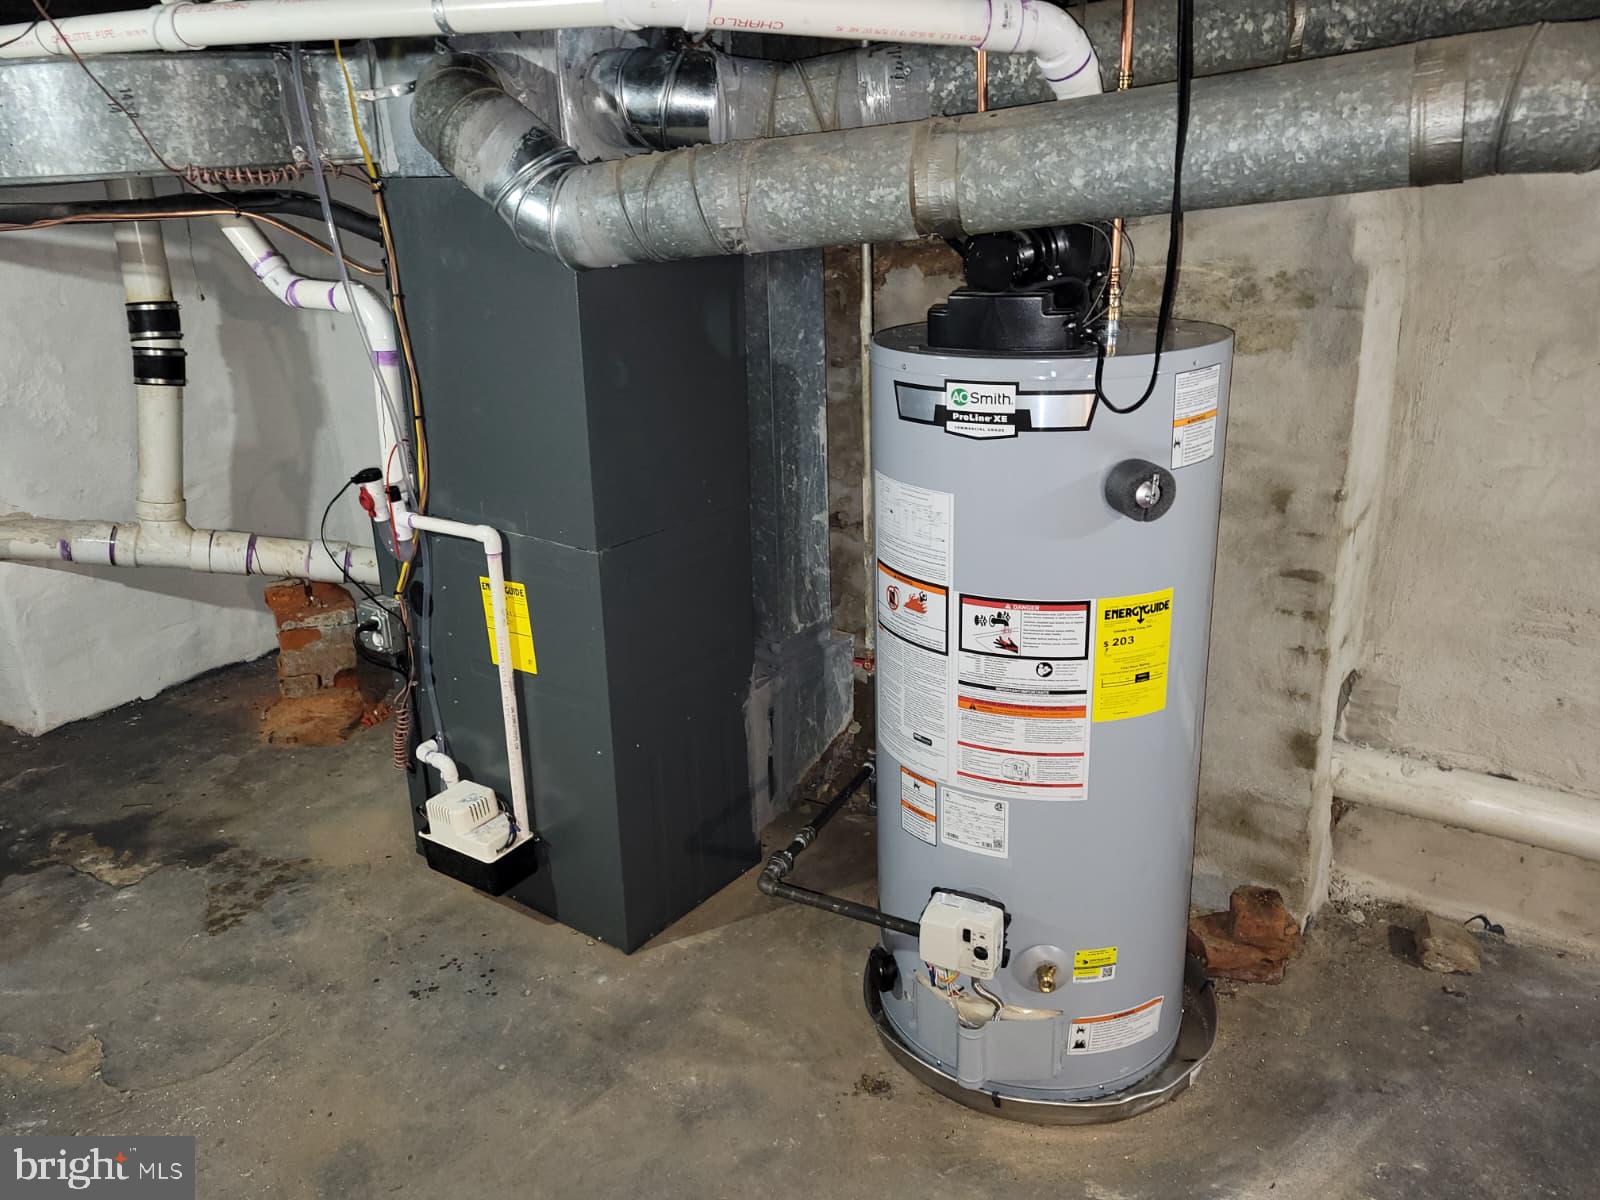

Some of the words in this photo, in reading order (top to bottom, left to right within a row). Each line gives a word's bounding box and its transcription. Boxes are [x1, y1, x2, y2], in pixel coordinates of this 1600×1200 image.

[970, 391, 1011, 405] Smith
[993, 415, 1008, 423] XE
[1112, 636, 1135, 647] 203
